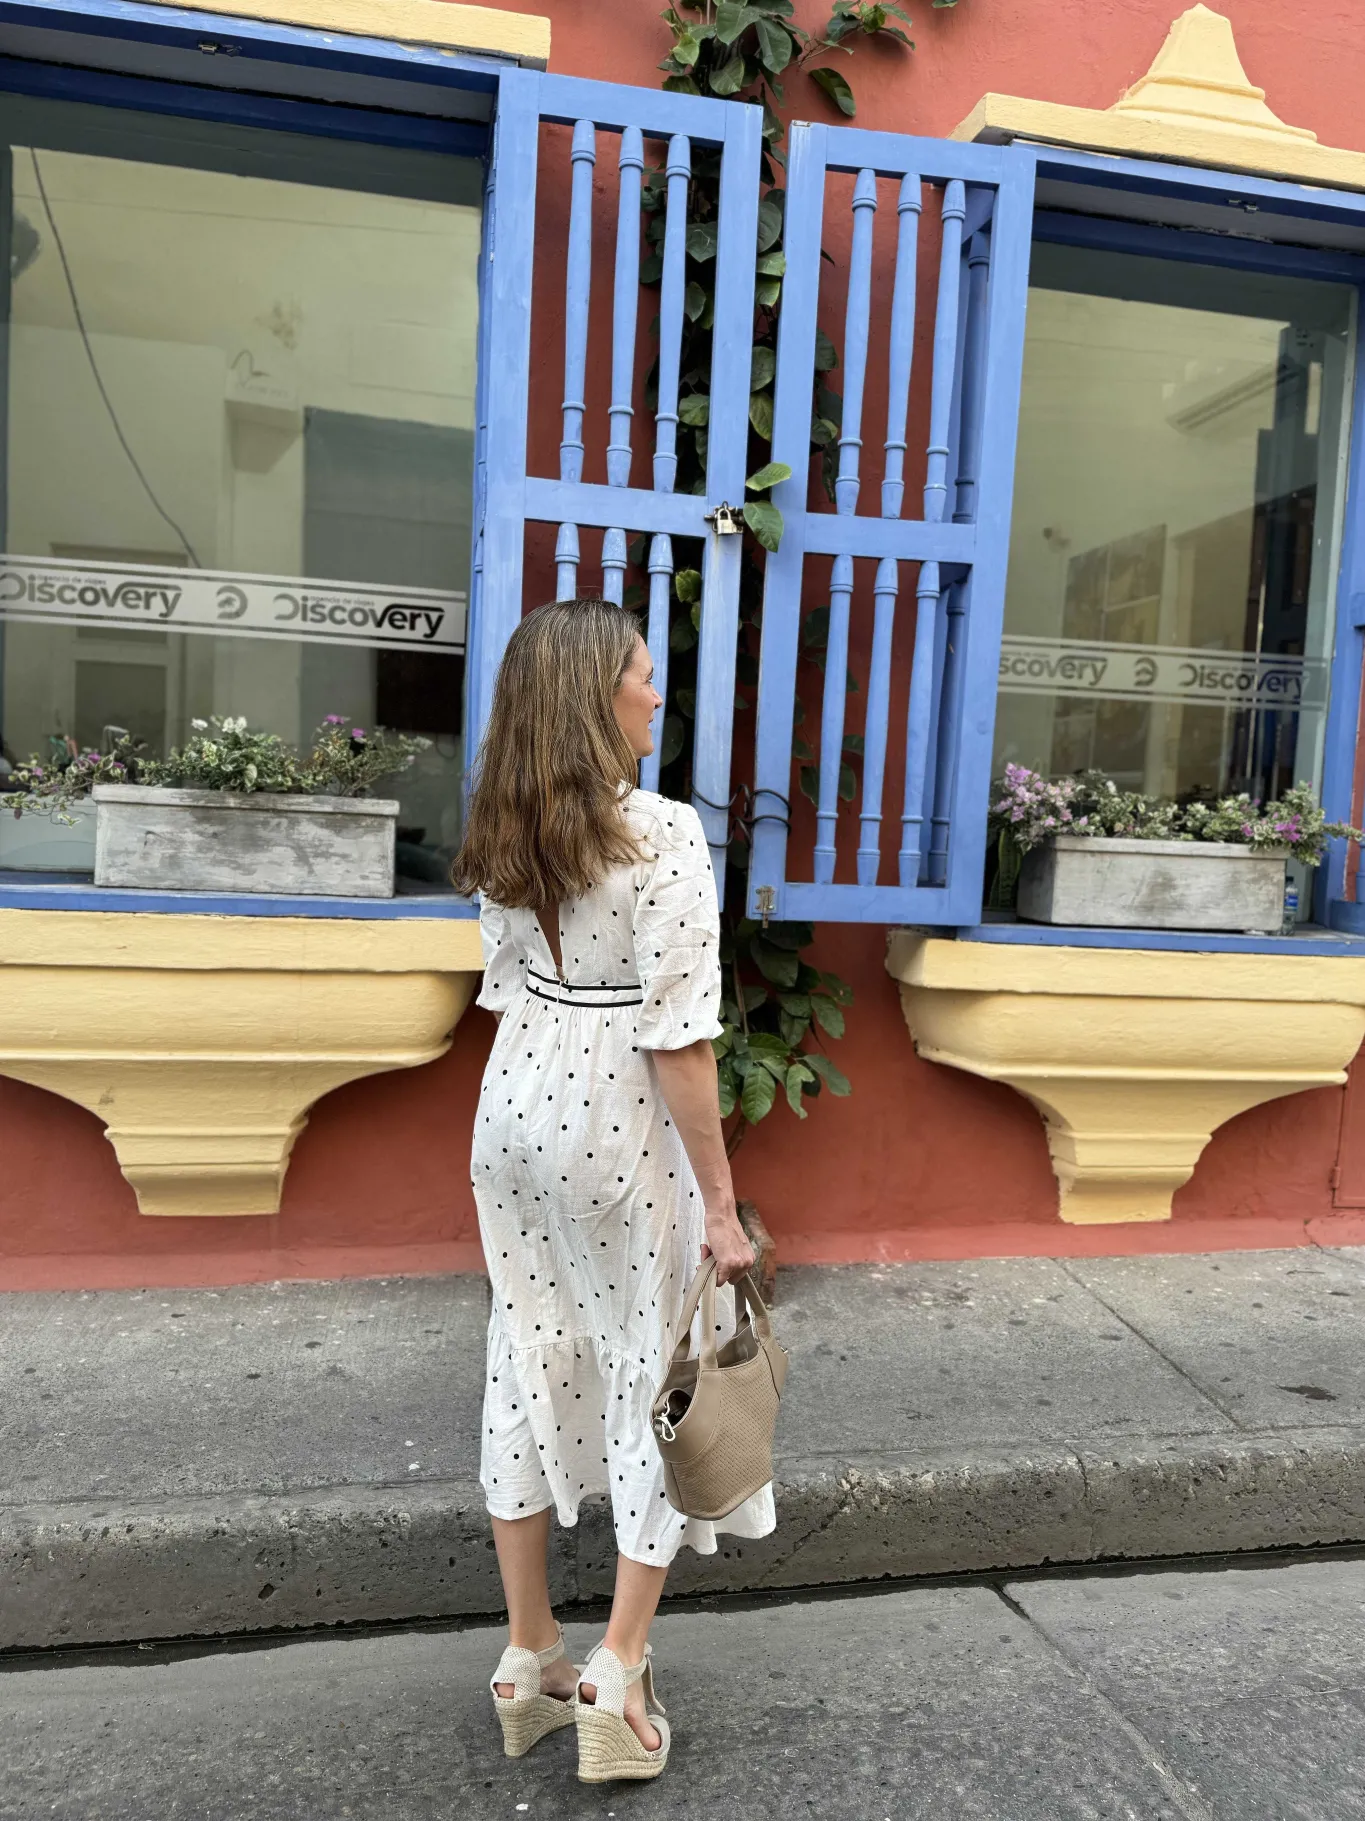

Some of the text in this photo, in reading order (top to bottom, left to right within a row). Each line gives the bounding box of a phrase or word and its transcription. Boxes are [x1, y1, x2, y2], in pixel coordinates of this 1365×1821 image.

[0, 572, 182, 618] Discovery
[273, 593, 445, 639] Discovery
[999, 654, 1108, 687] scovery
[1178, 663, 1310, 699] Discovery
